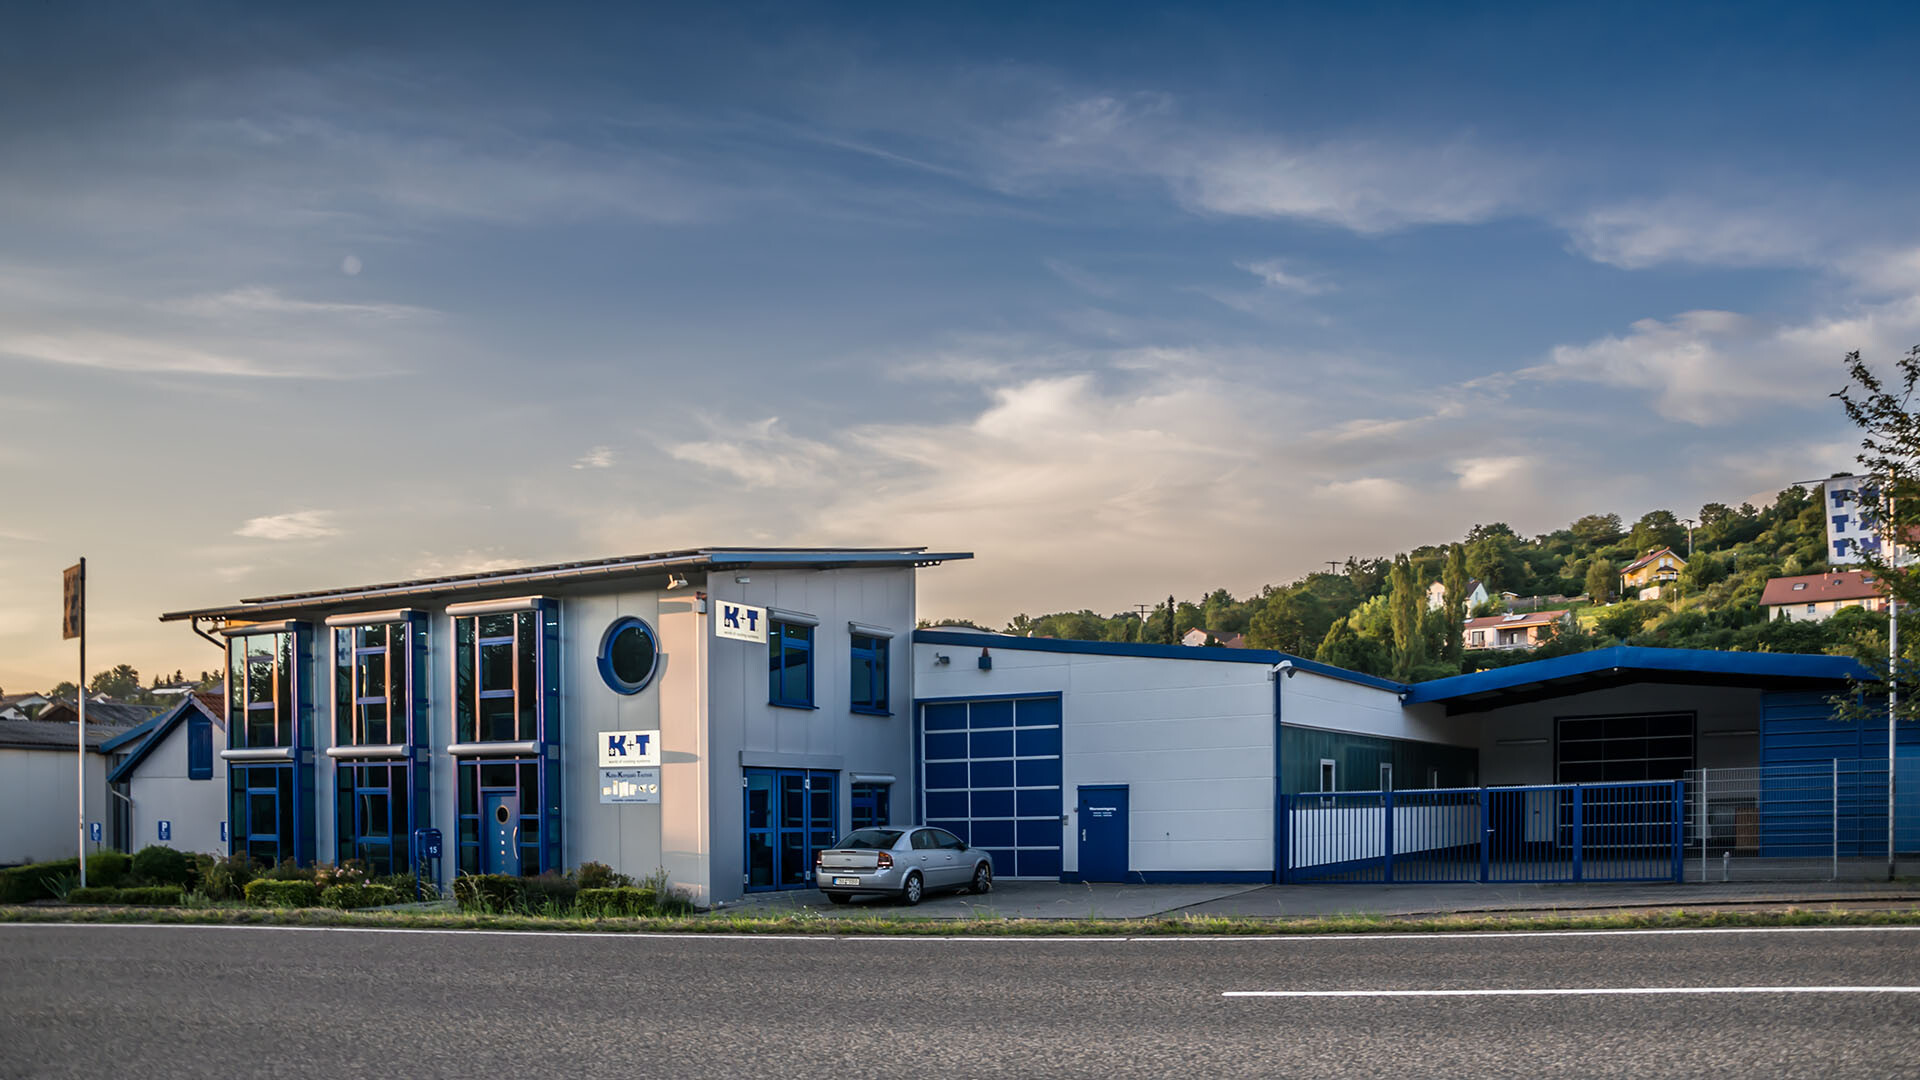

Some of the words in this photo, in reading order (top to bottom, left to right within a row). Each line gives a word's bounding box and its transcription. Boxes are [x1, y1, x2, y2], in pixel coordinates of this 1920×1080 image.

[724, 605, 759, 632] K+T
[608, 734, 650, 757] K+T
[429, 846, 438, 854] 15
